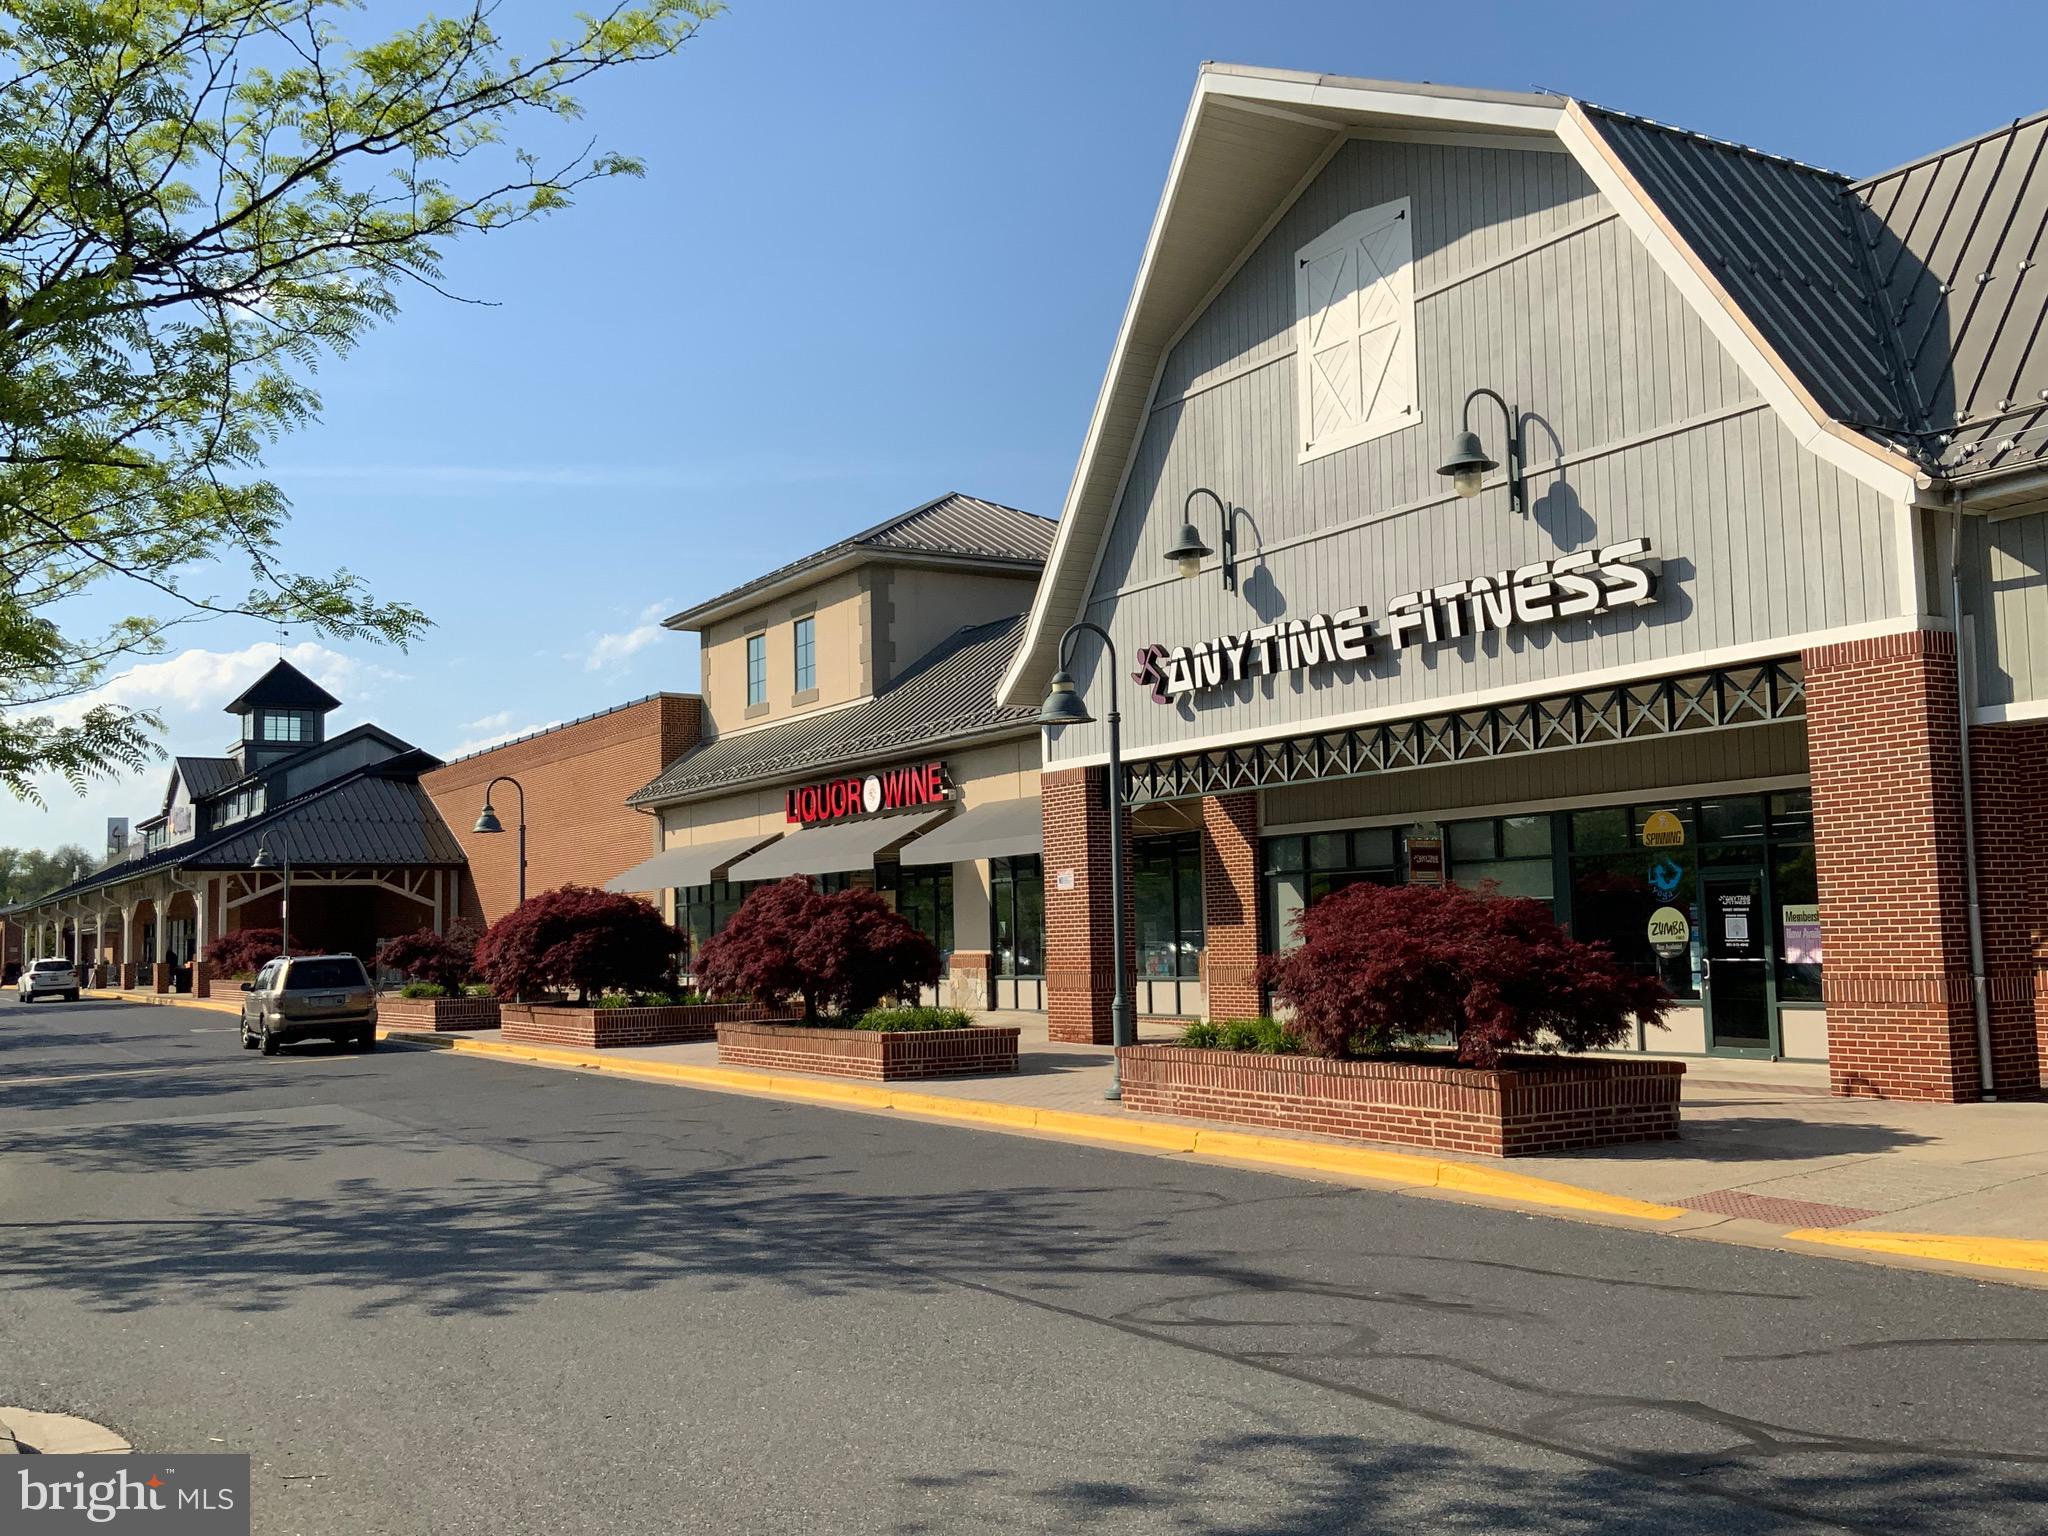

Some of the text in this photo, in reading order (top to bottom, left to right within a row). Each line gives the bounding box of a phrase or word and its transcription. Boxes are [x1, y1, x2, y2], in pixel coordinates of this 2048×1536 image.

[1167, 537, 1657, 694] ANYTIME FITNESS
[784, 761, 946, 824] LIQUOR WINE
[1646, 830, 1682, 846] SPINNING
[1650, 920, 1686, 936] ZUMBA
